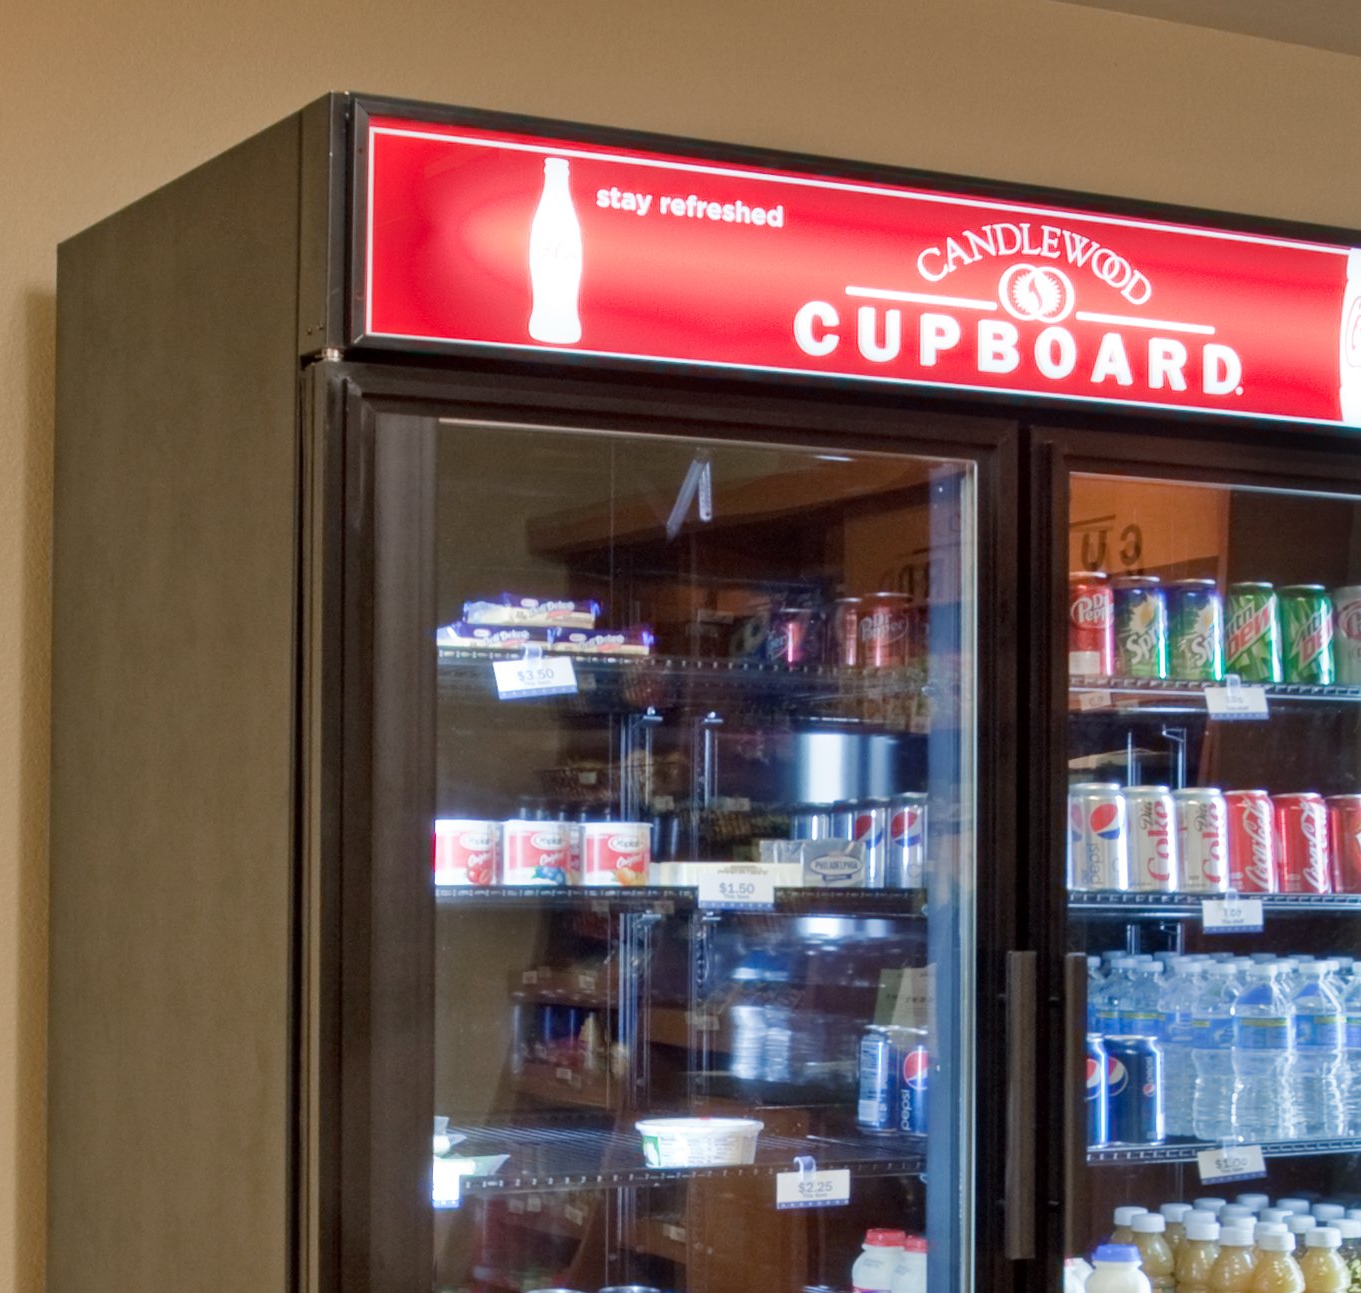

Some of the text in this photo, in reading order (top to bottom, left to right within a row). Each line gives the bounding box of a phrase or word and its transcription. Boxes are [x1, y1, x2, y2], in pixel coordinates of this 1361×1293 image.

[596, 187, 784, 228] stay refreshed
[917, 223, 1152, 305] CANDLEWOOD
[719, 882, 755, 895] $1.50
[901, 1089, 911, 1131] pepsi
[798, 1181, 833, 1194] $2.25
